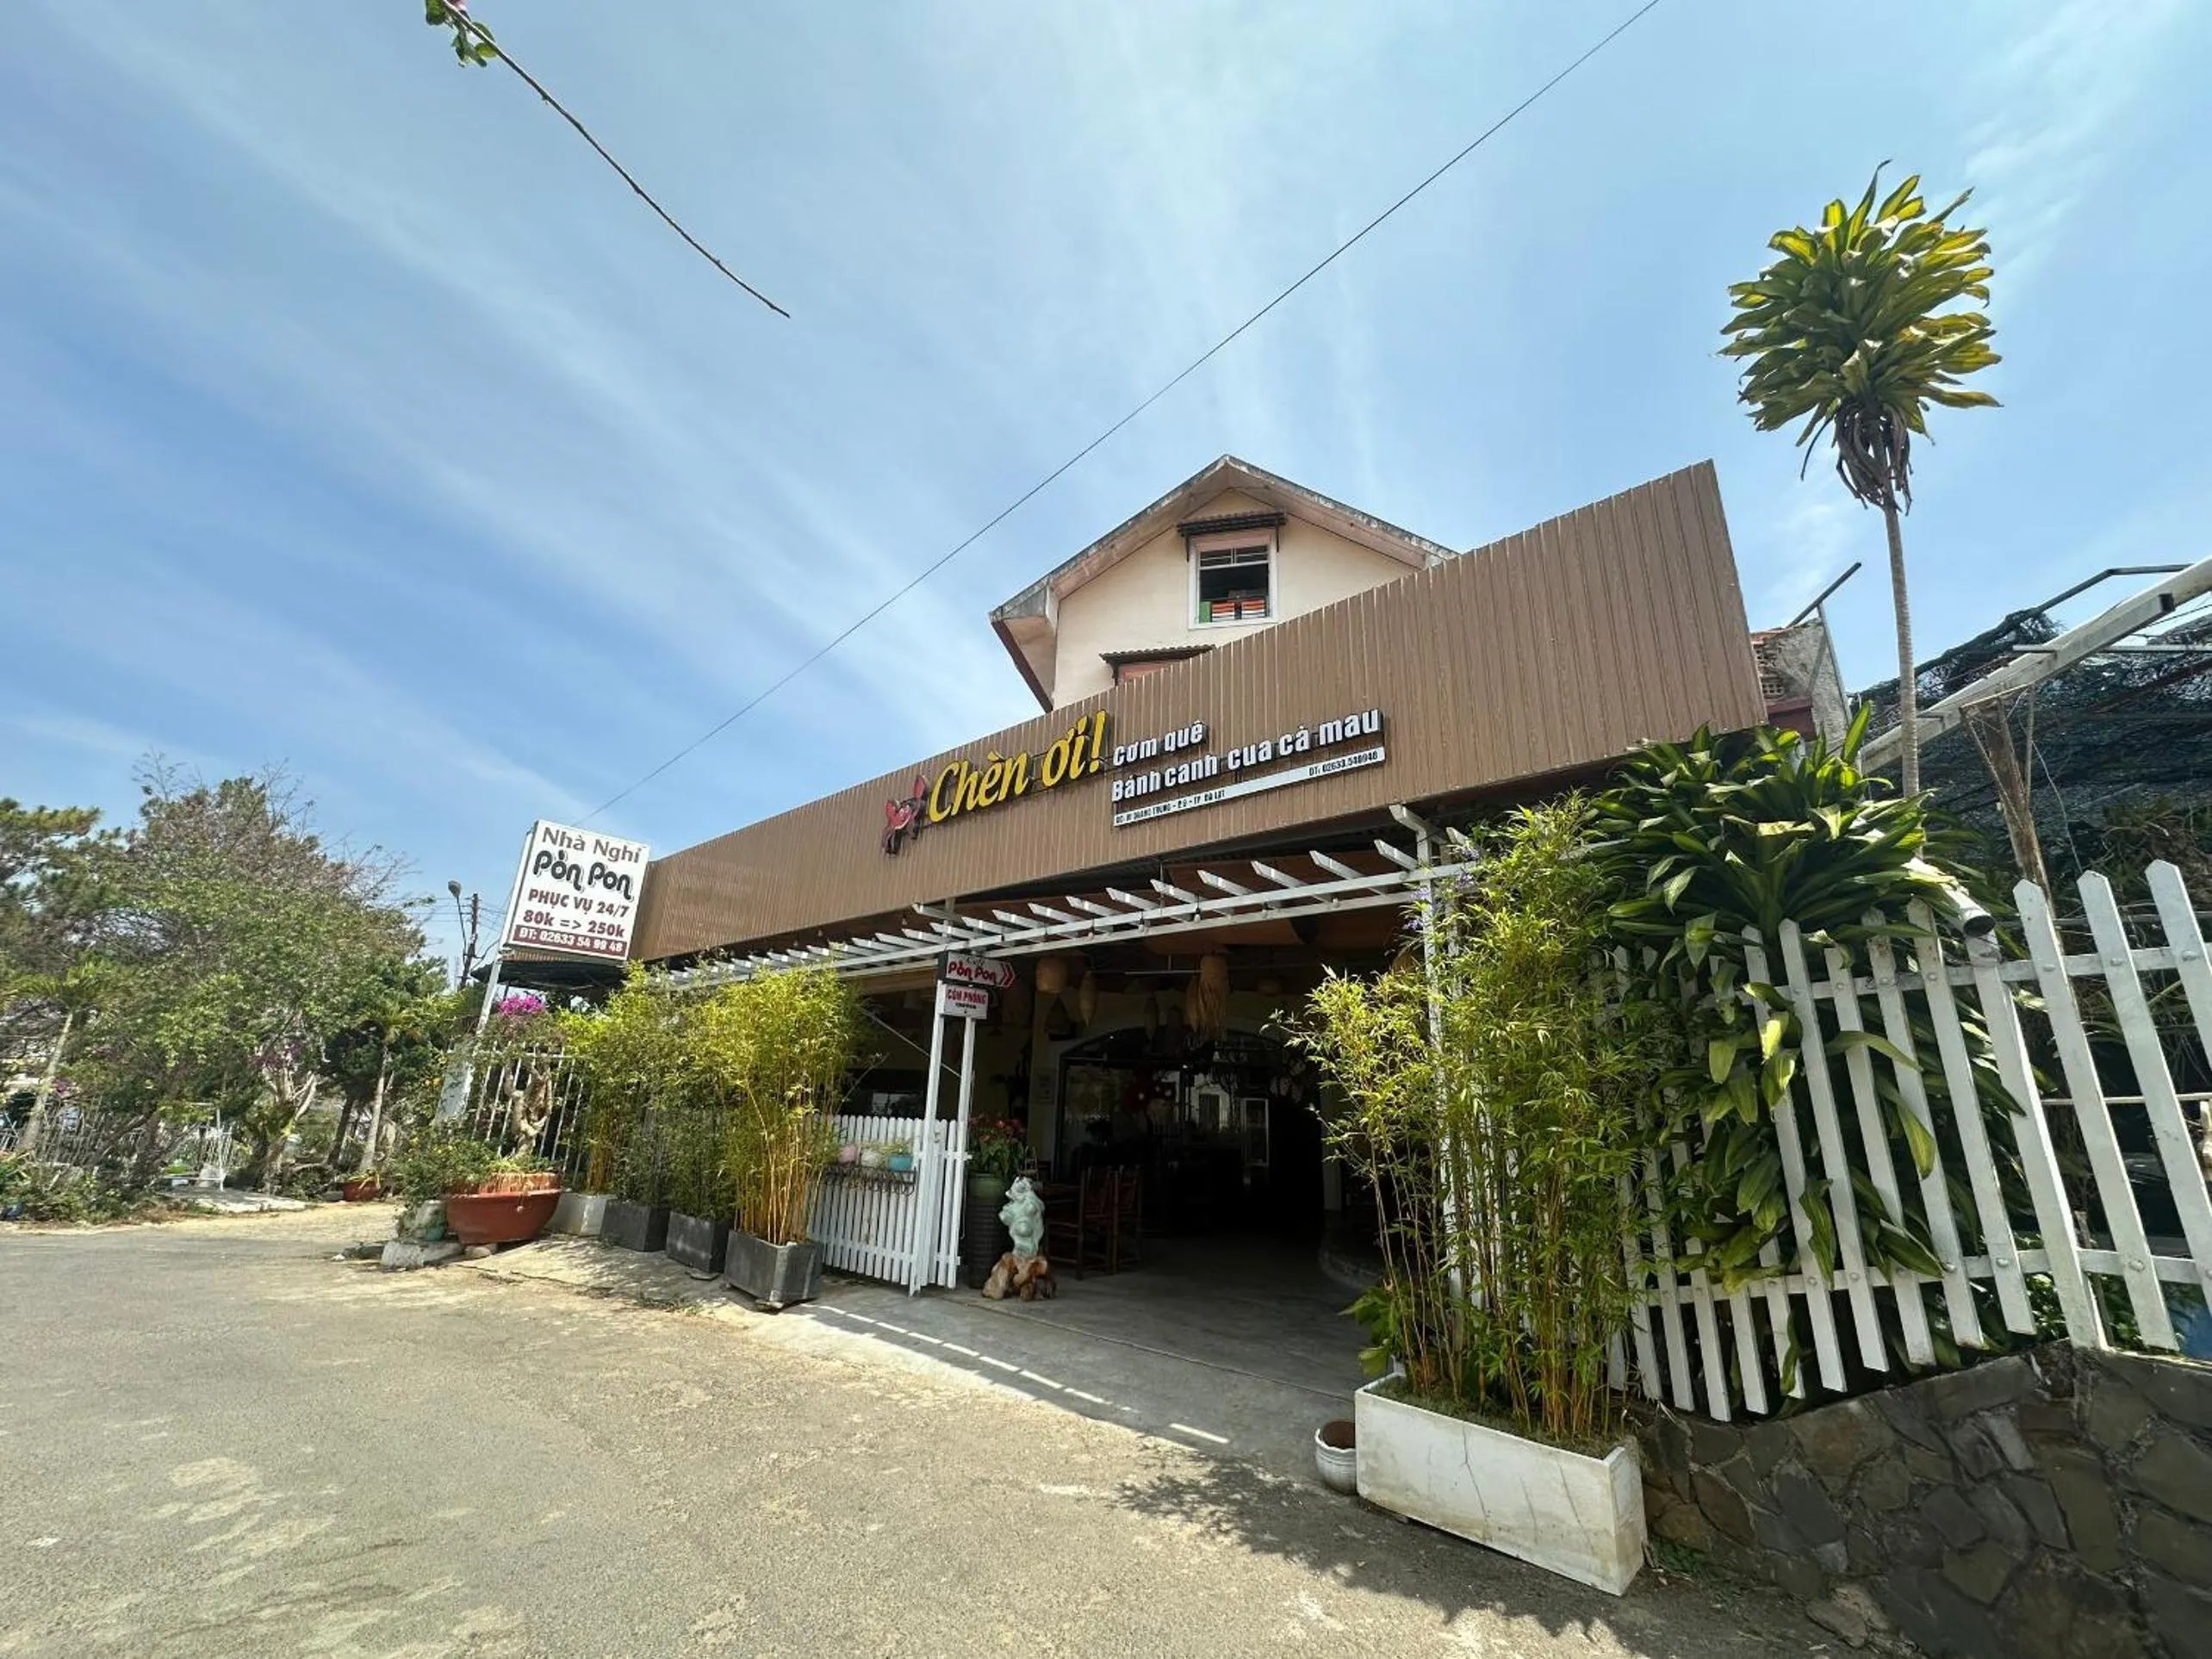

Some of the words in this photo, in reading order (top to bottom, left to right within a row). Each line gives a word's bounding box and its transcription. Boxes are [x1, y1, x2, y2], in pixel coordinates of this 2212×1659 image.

[1164, 719, 1203, 752] quê
[1111, 771, 1161, 802] Bánh
[1165, 755, 1217, 787] canh
[1227, 740, 1272, 770] cua
[1279, 725, 1309, 756] cà
[1319, 709, 1379, 745] mau
[928, 751, 1028, 823] Chèn
[542, 827, 586, 852] Nhà
[587, 861, 632, 900] Pon
[528, 889, 569, 910] PHỤC
[574, 896, 593, 915] VỤ
[596, 902, 630, 917] 24/7
[523, 910, 555, 927] 80k
[587, 920, 625, 938] 250k
[519, 927, 537, 940] ĐT:
[539, 930, 575, 946] 02633
[577, 935, 591, 948] 54
[608, 942, 623, 952] 48
[974, 966, 997, 984] Pon
